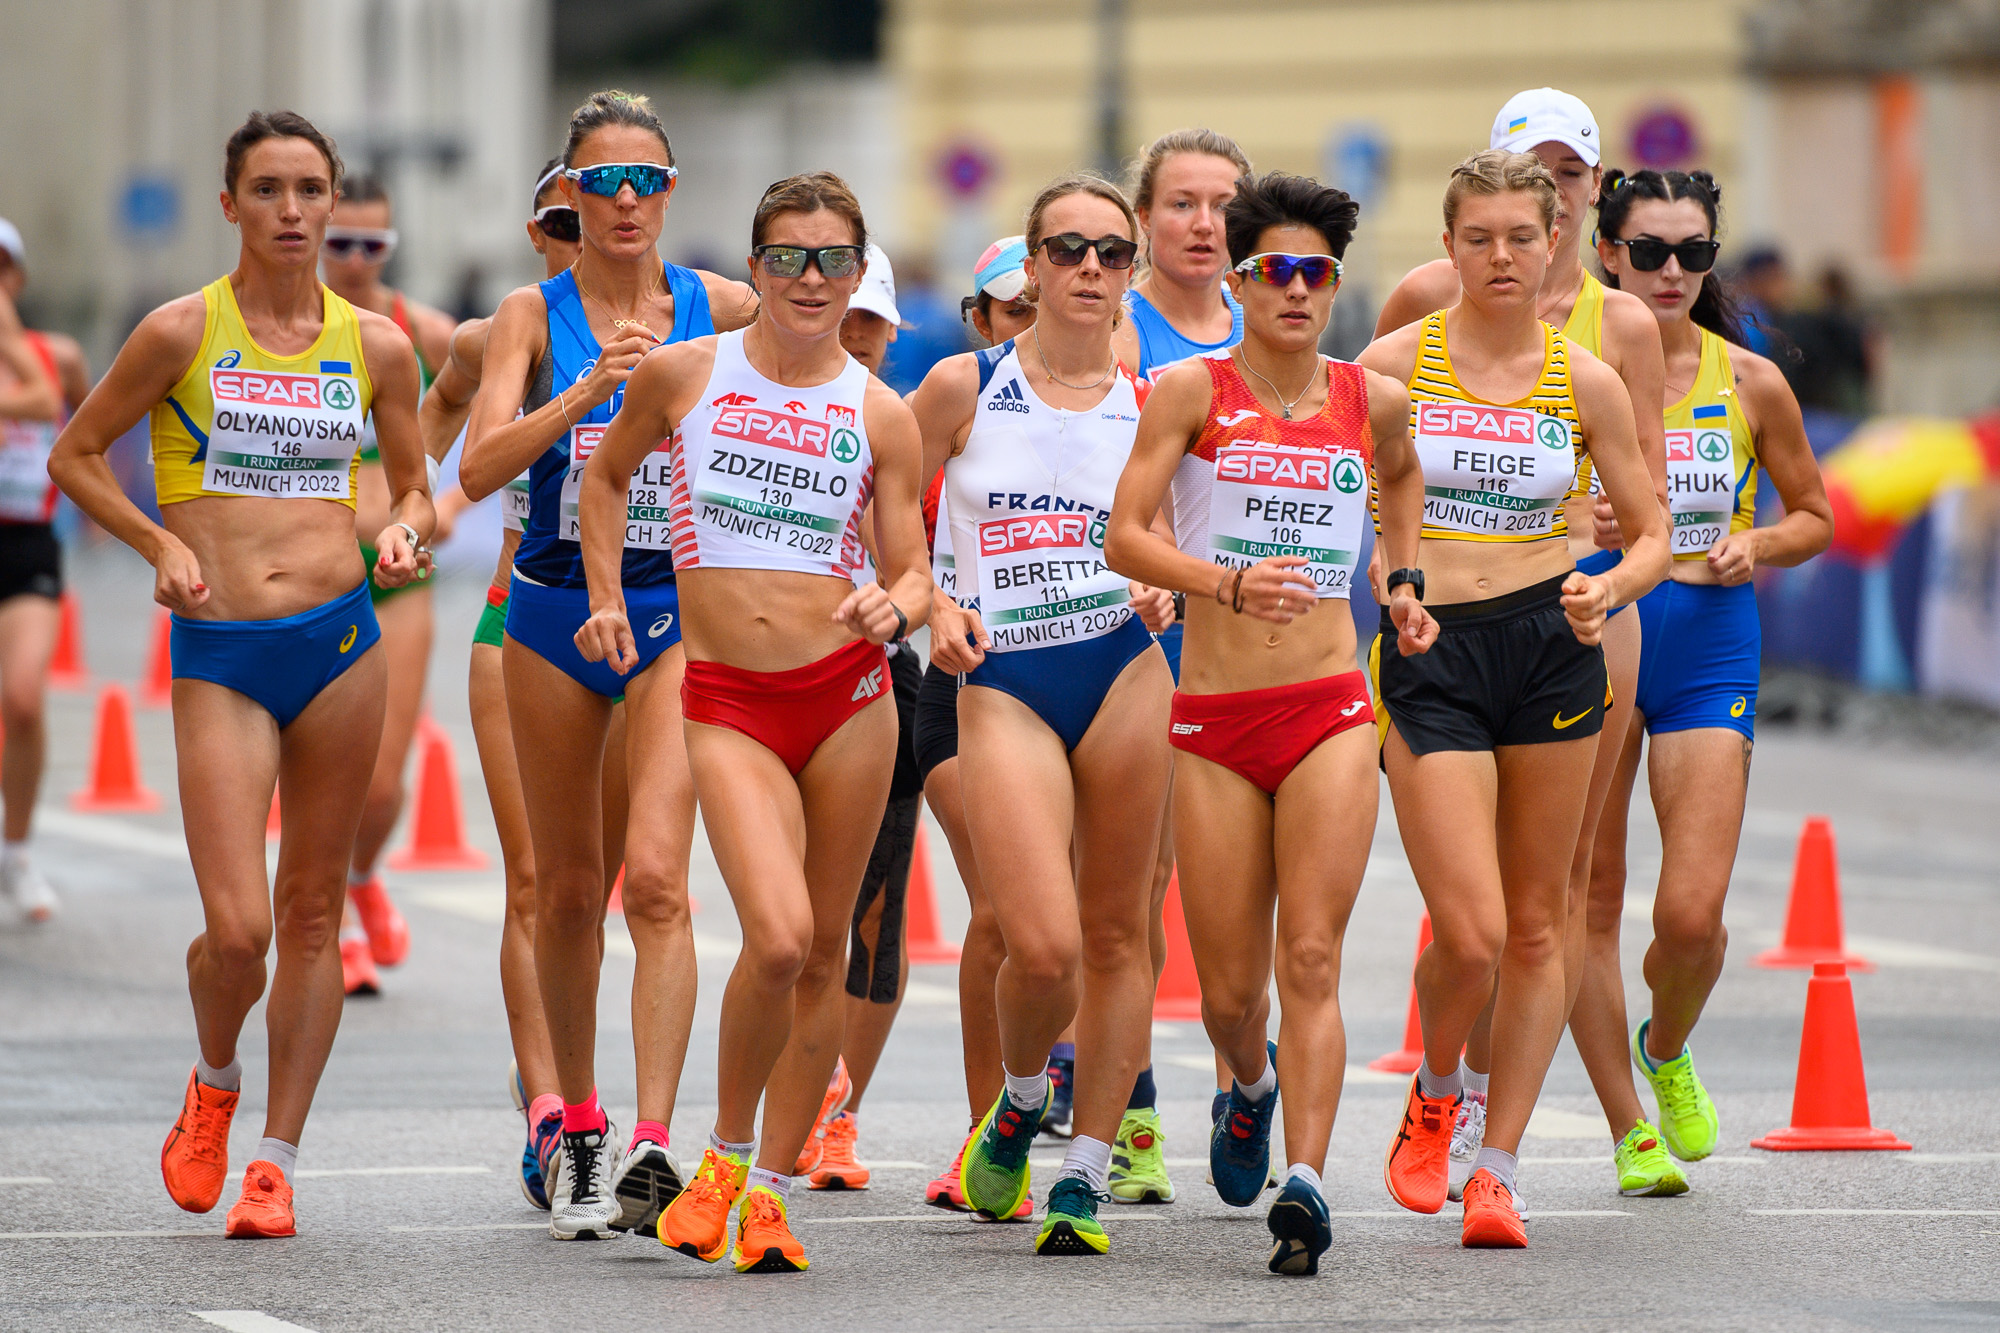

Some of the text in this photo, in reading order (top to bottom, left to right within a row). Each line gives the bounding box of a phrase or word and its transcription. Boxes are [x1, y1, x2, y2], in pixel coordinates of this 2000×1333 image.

[216, 375, 318, 405] SPAR
[987, 398, 1030, 414] adidas
[216, 410, 357, 441] OLYANOVSKA
[716, 411, 827, 452] SPAR
[1423, 408, 1531, 440] SPAR
[271, 441, 302, 456] 146
[250, 456, 279, 469] RUN
[1220, 454, 1327, 486] SPAR
[1453, 450, 1535, 478] FEIGE
[213, 468, 341, 492] MUNICH 2022
[708, 449, 848, 498] ZDZIEBLO
[1477, 477, 1509, 493] 116
[627, 489, 657, 506] 128
[760, 487, 793, 507] 130
[1455, 490, 1484, 504] RUN
[638, 508, 670, 520] CLEA
[736, 500, 768, 516] RUN
[1245, 495, 1334, 527] PÉREZ
[1423, 500, 1547, 531] MUNICH 2022
[702, 505, 782, 543] MUNICH
[787, 529, 834, 555] 2022
[983, 518, 1085, 551] SPAR
[1271, 526, 1302, 544] 106
[1678, 527, 1722, 547] 2022
[1249, 543, 1278, 557] RUN
[993, 560, 1111, 590] BERETTA
[1303, 567, 1347, 587] 2022
[1040, 585, 1070, 603] 111
[1025, 604, 1054, 620] RUN
[993, 608, 1131, 648] MUNICH 2022
[1171, 722, 1204, 736] ESP
